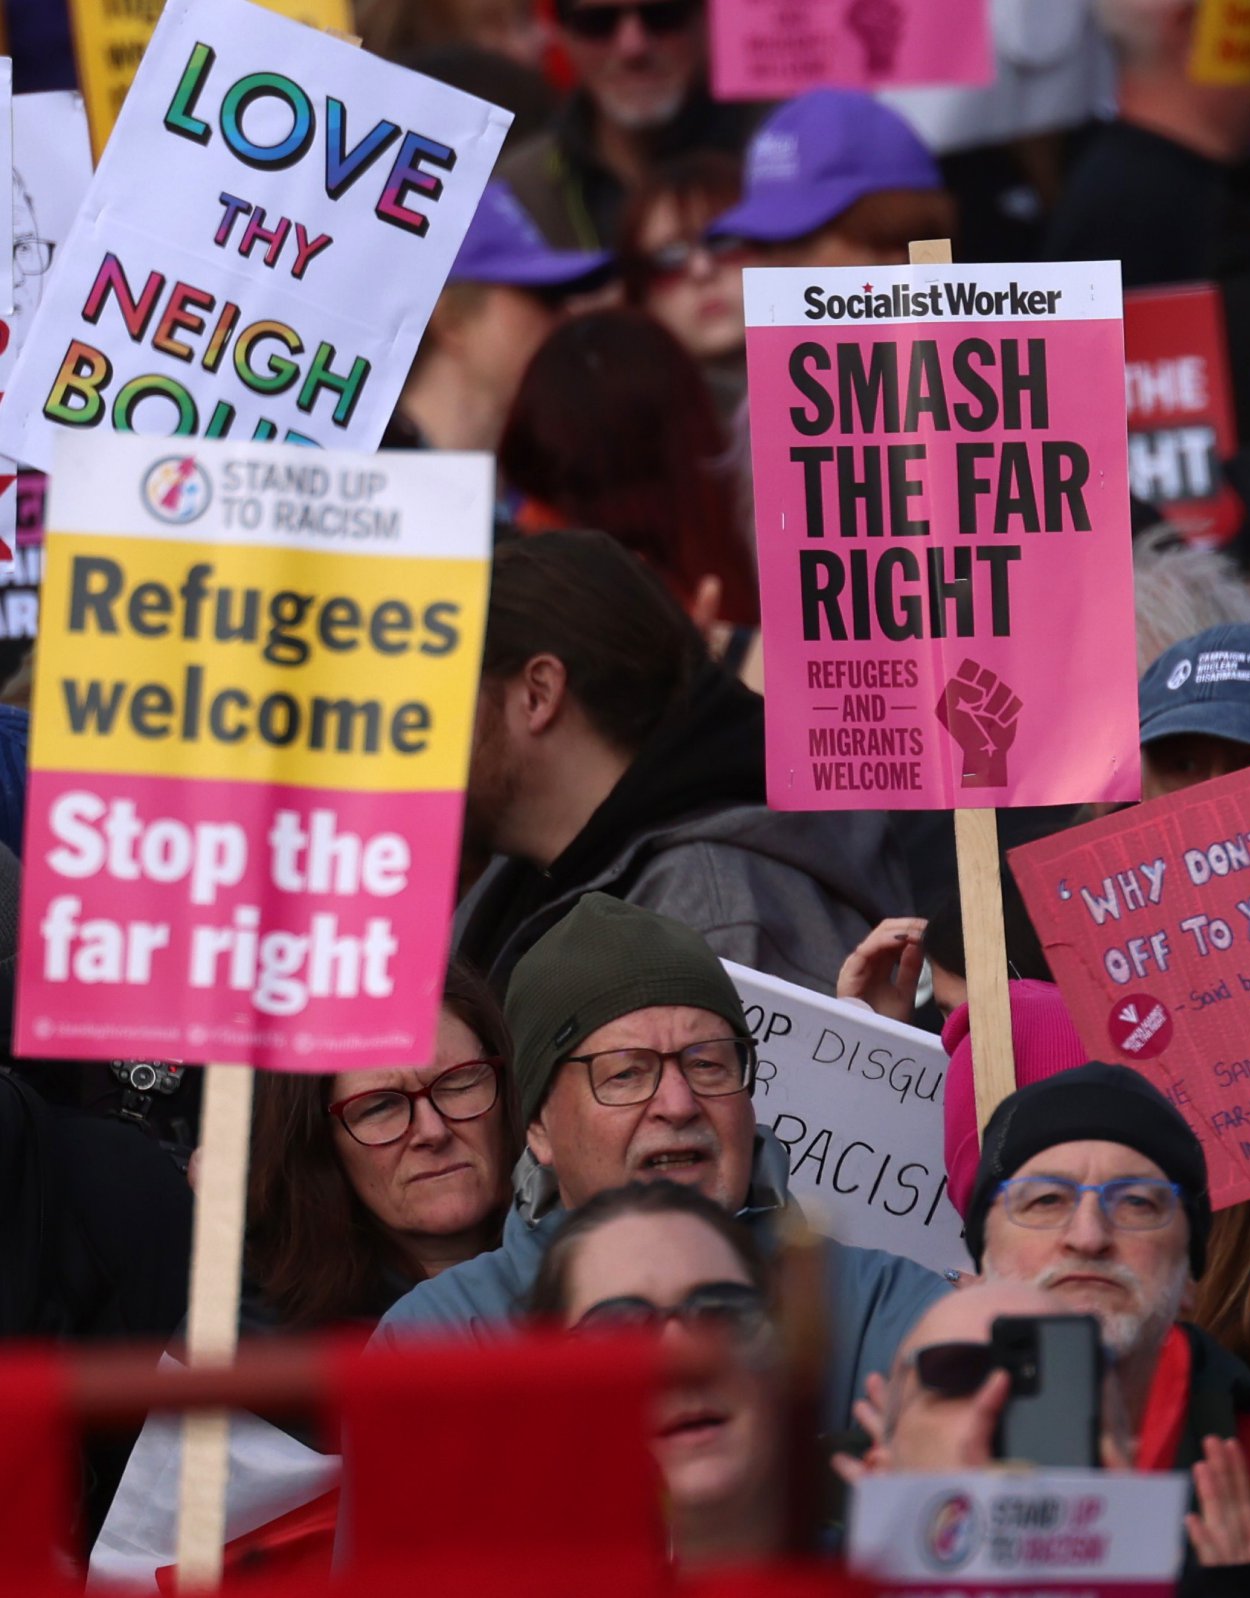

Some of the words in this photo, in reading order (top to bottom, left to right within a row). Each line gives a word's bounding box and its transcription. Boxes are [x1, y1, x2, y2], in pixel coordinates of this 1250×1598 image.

[164, 41, 456, 237] LOVE
[214, 192, 333, 280] THY
[82, 253, 371, 427] NEIGH
[789, 338, 1049, 437] SMASH
[43, 338, 326, 451] BO
[222, 459, 329, 499] STAND
[340, 470, 388, 498] UP
[223, 499, 263, 530] TO
[275, 503, 401, 540] RACISM
[790, 444, 930, 538] THE
[955, 441, 1092, 535] FAR
[67, 554, 462, 668] Refugees
[799, 545, 1021, 642] RIGHT
[62, 665, 433, 754] welcome
[807, 660, 919, 690] REFUGEES
[841, 694, 886, 723] AND
[808, 727, 923, 758] MIGRANTS
[812, 762, 923, 791] WELCOME
[47, 790, 247, 905] Stop
[270, 809, 411, 897] the
[41, 895, 170, 985] far
[189, 906, 397, 1016] right
[1104, 930, 1170, 985] OFF
[740, 1000, 792, 1043] OP
[812, 1028, 943, 1104] DISGU
